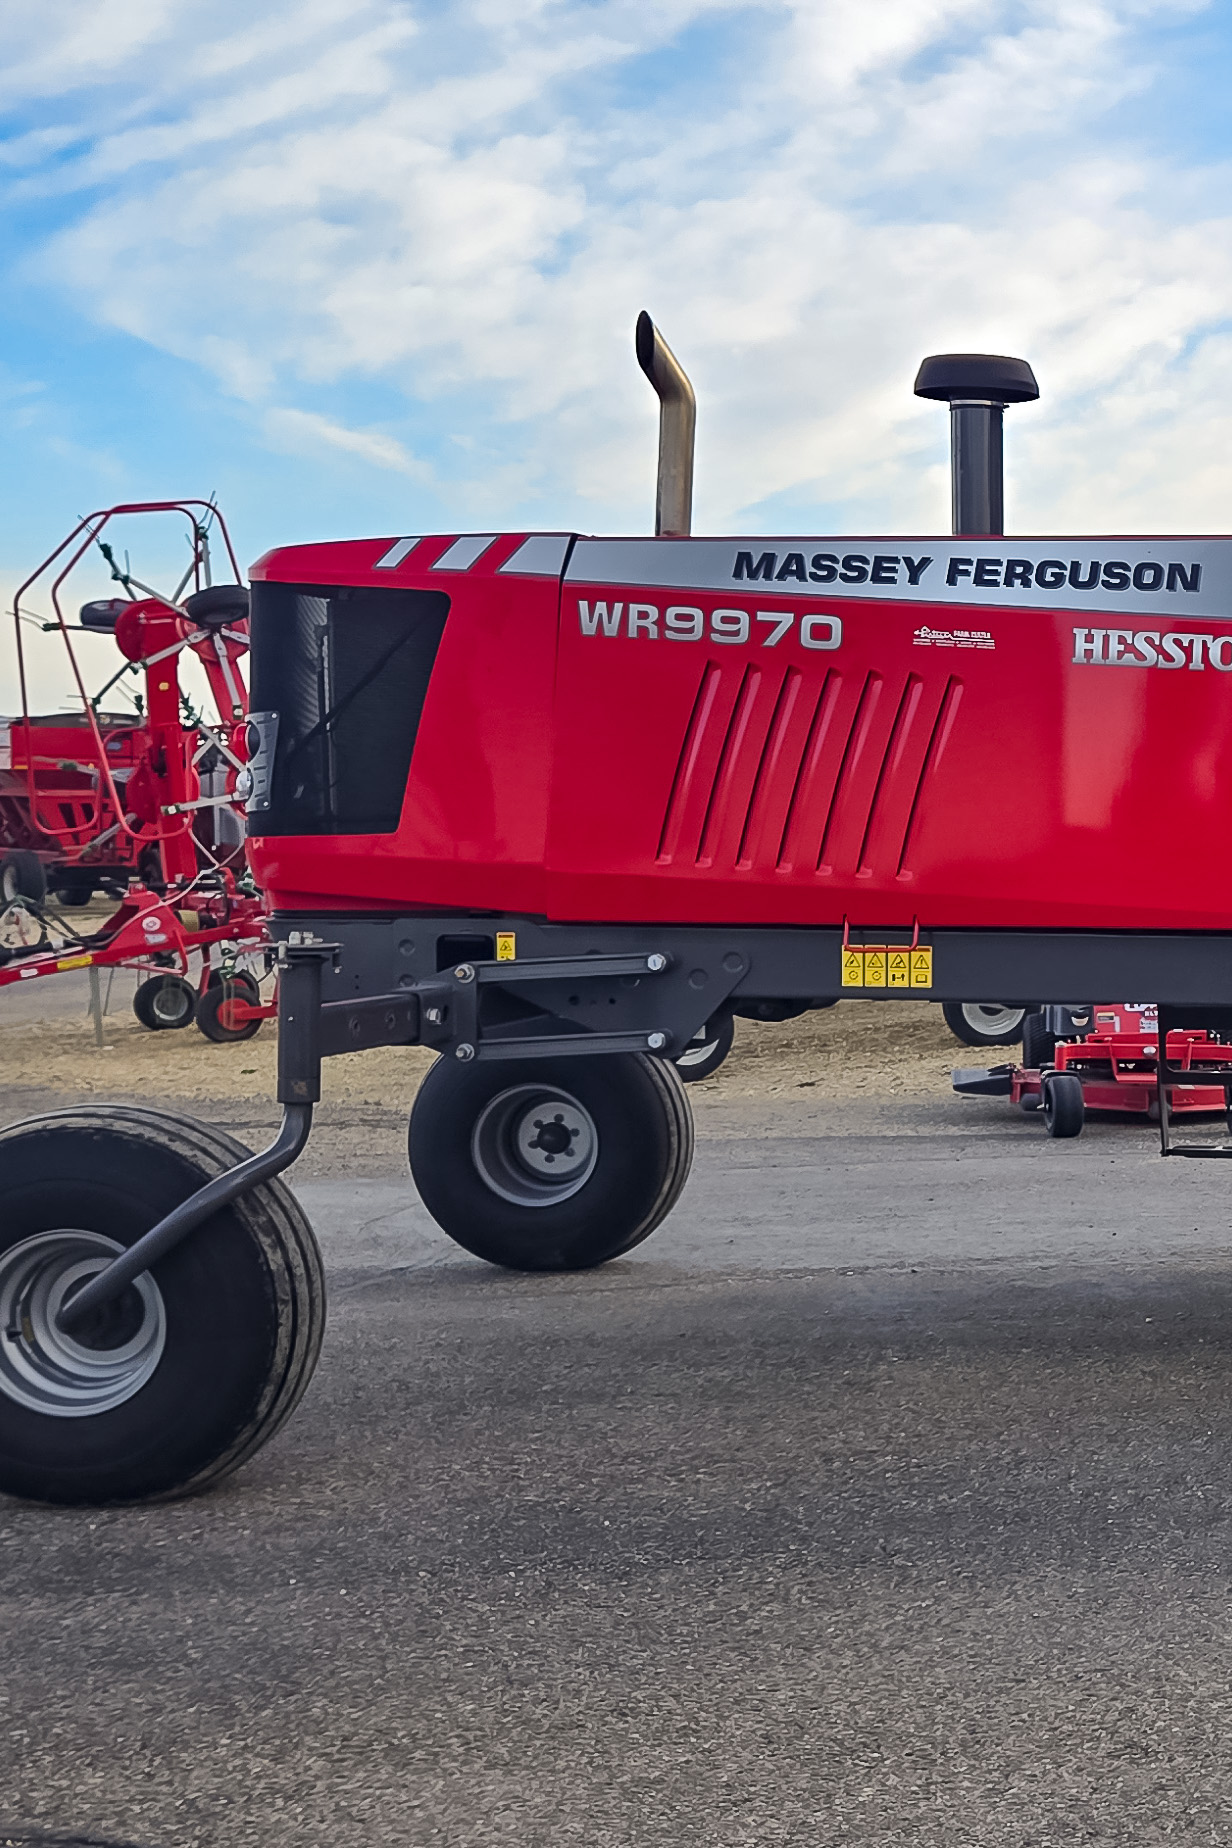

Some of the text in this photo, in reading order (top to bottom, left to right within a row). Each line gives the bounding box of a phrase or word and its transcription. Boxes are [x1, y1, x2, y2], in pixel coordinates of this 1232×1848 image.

[732, 551, 1202, 593] MASSEY FERGUSON
[578, 600, 843, 651] WR9970
